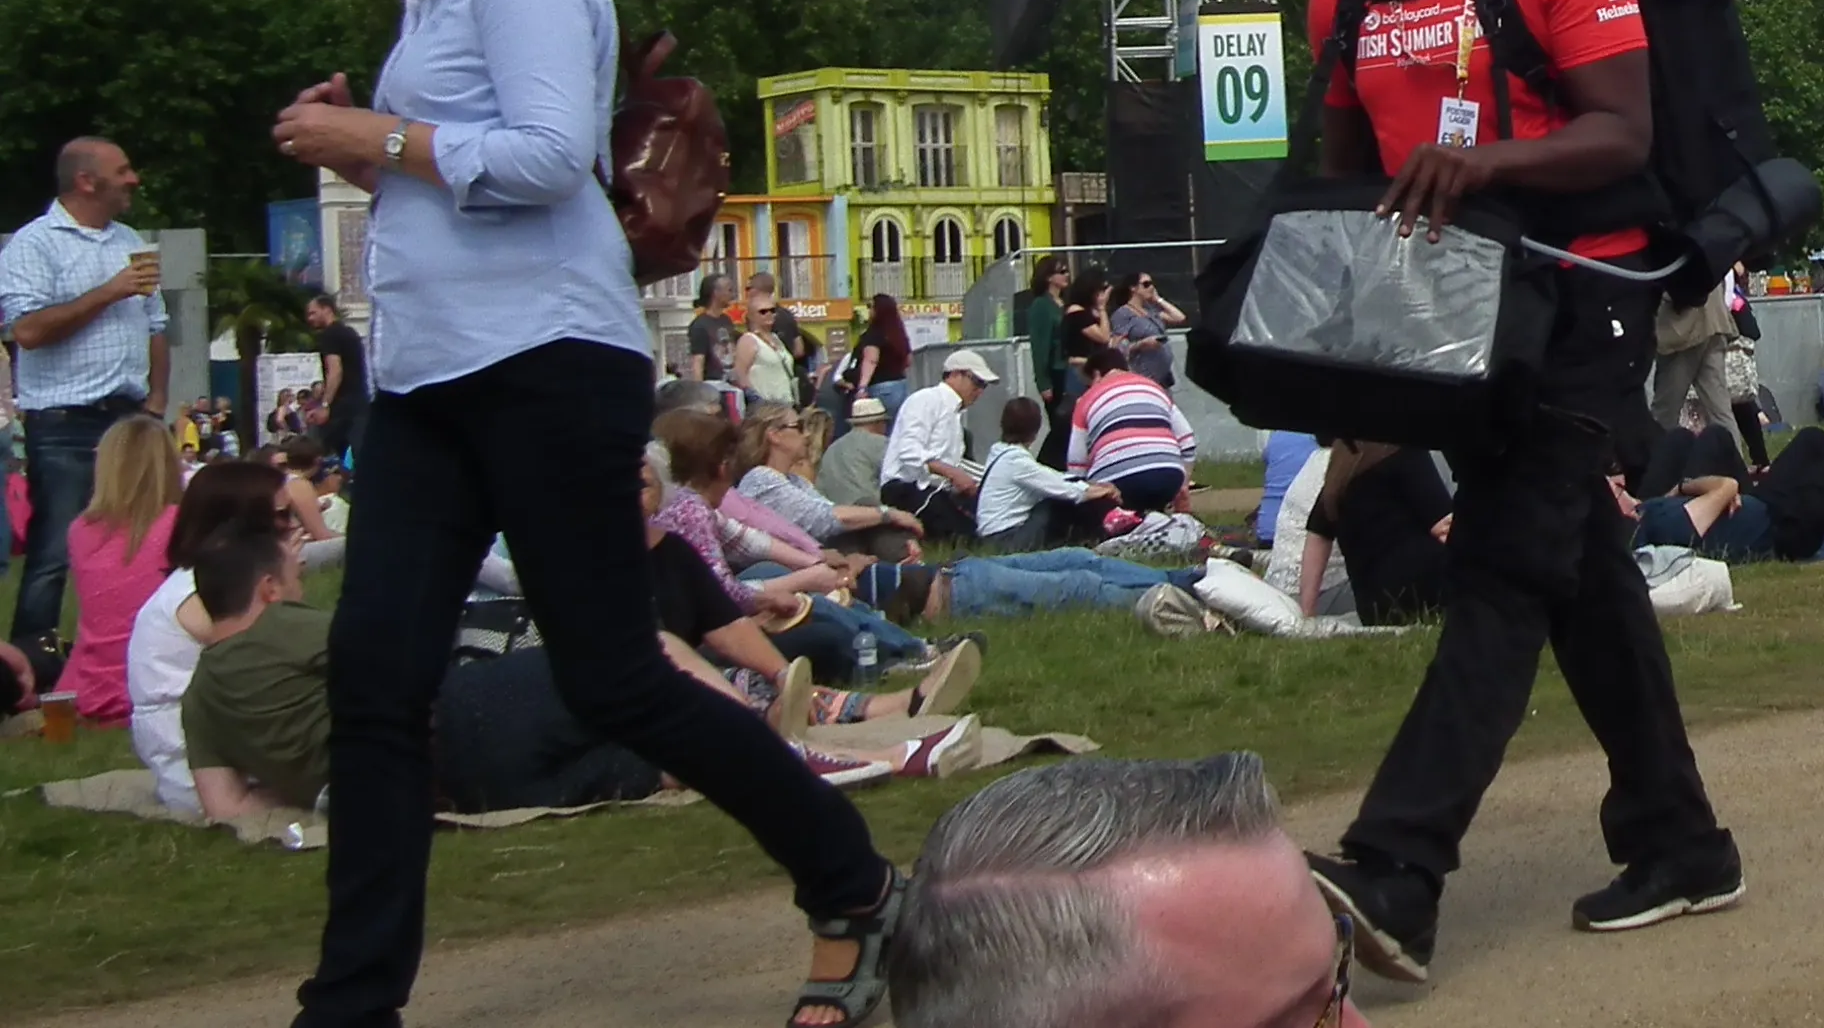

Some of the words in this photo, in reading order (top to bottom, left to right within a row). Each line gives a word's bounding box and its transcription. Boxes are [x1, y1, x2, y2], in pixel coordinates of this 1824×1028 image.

[1213, 33, 1267, 58] DELAY
[1390, 21, 1454, 57] SUMMER
[1216, 64, 1270, 125] 09
